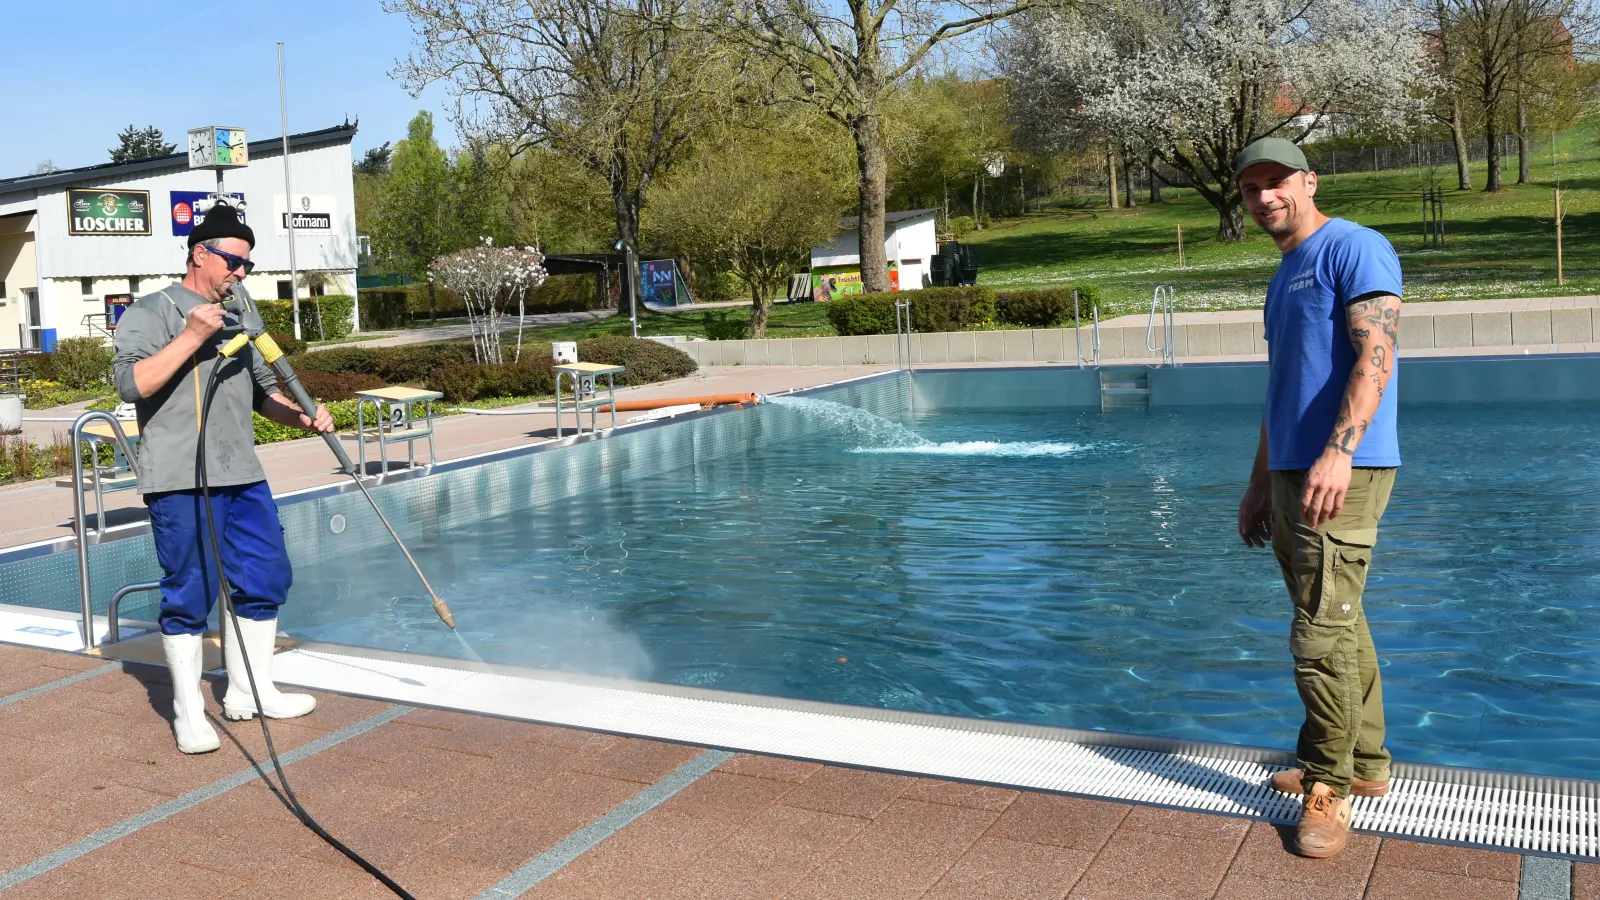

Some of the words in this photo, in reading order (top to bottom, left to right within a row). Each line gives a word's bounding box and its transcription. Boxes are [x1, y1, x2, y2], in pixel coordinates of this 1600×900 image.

[74, 216, 145, 231] LOSCHER
[1288, 278, 1314, 293] TEAM
[583, 379, 592, 396] 3
[393, 408, 404, 428] 2
